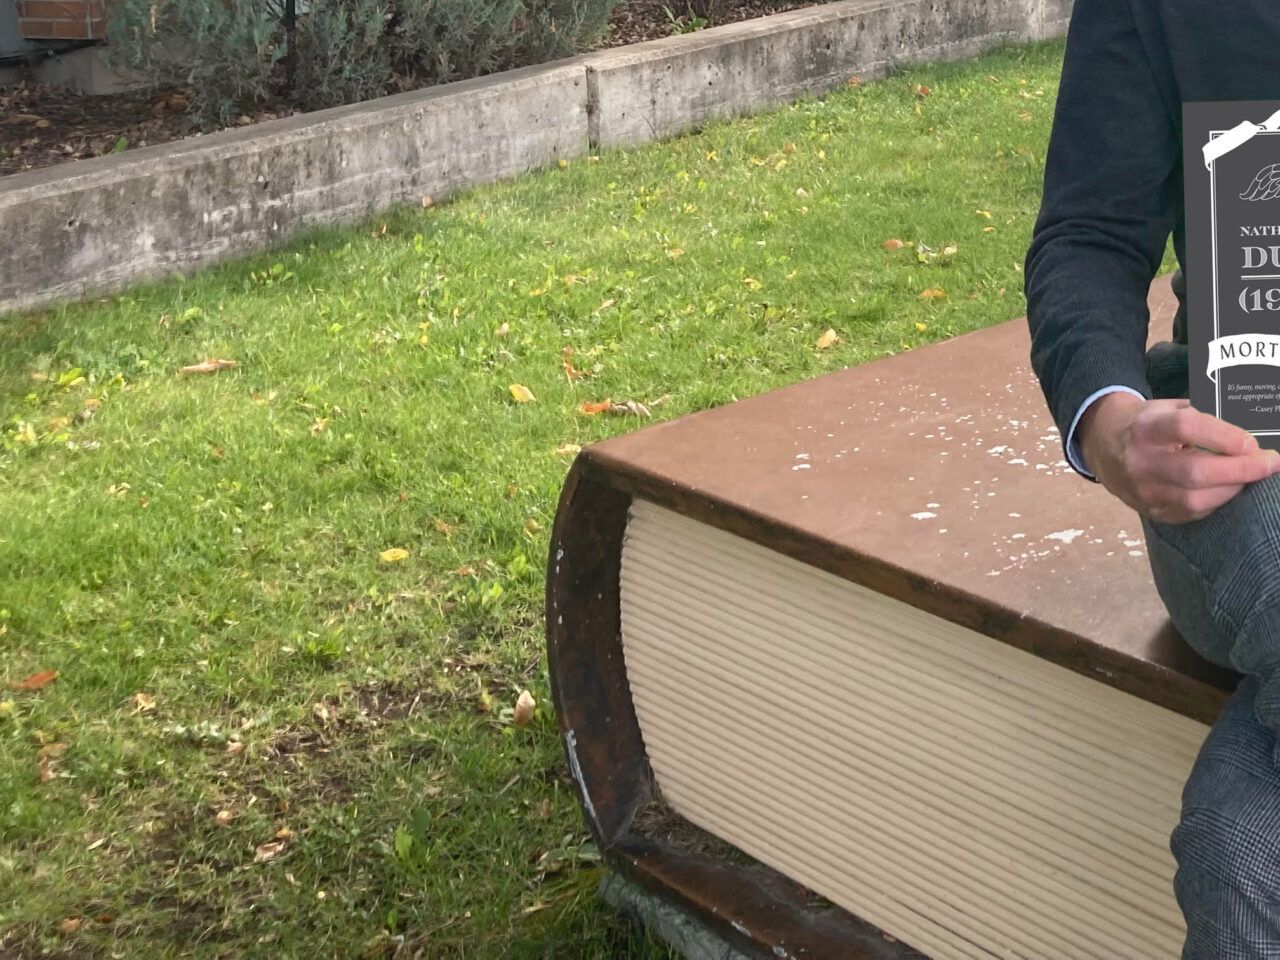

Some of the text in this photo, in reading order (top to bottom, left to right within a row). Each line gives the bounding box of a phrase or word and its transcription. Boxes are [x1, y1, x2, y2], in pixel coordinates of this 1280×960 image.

[1235, 383, 1254, 392] funny,
[1242, 393, 1275, 402] appropriate
[1275, 392, 1280, 400] of
